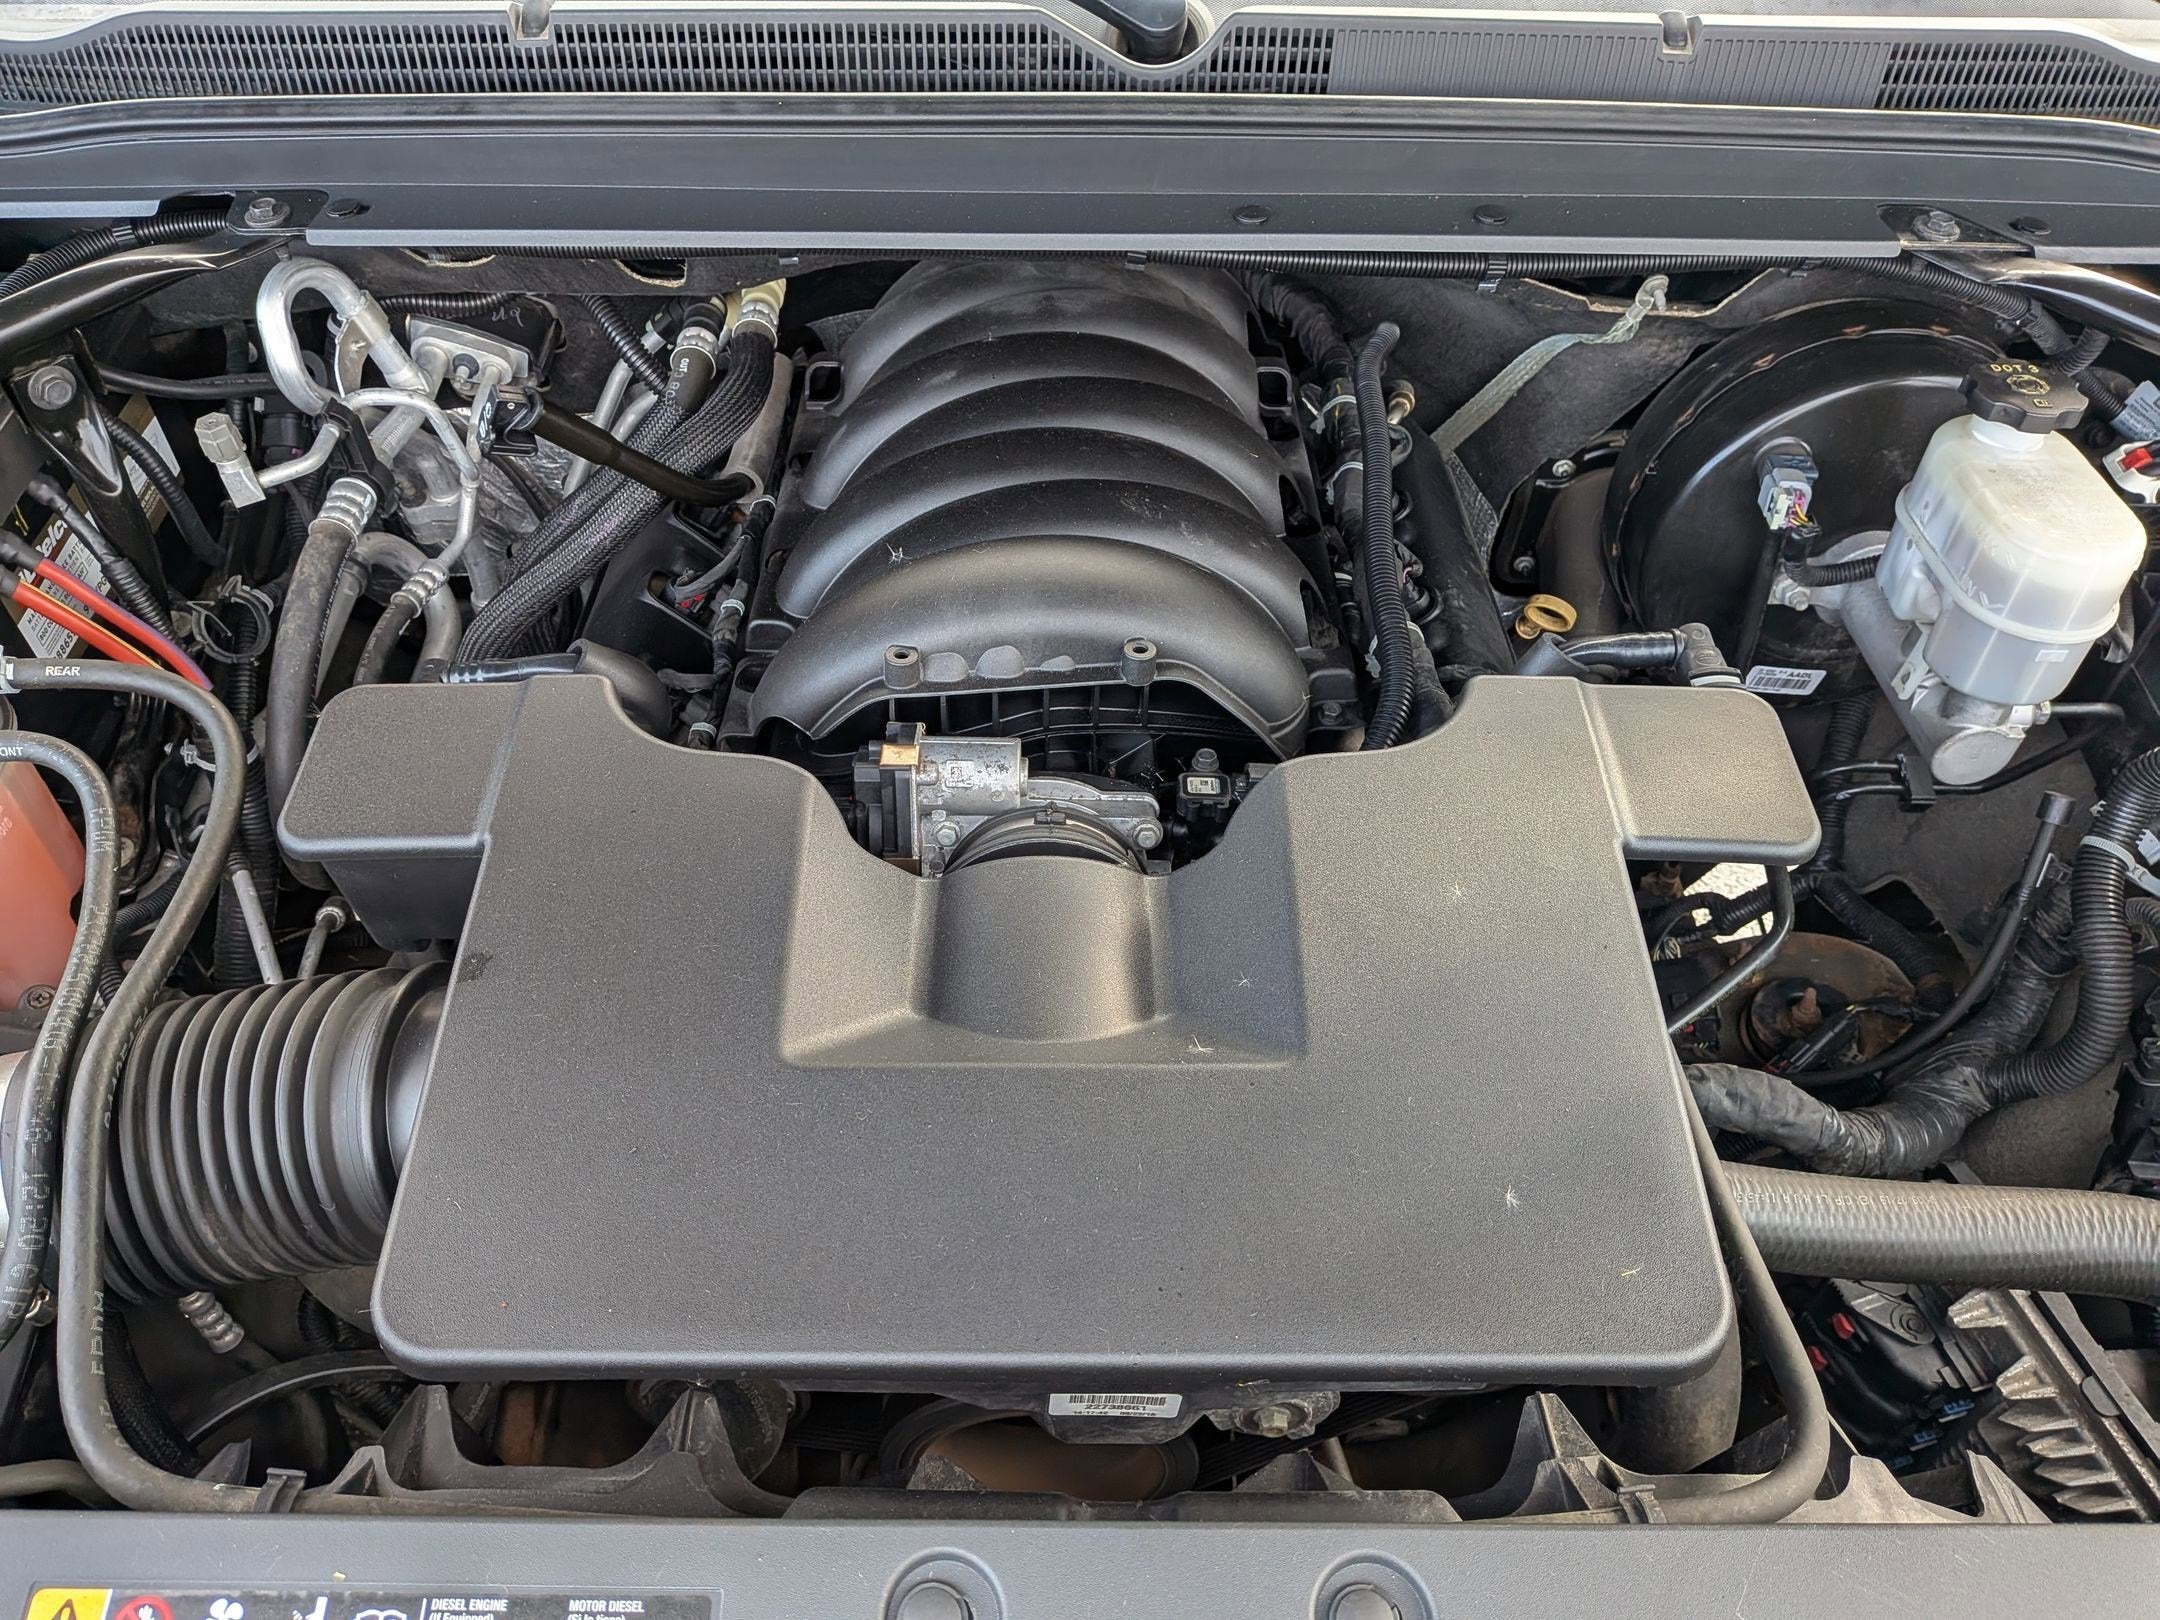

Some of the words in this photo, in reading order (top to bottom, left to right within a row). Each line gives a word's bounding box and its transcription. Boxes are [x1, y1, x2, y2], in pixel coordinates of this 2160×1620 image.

[1990, 364, 2022, 373] DOT
[2028, 364, 2040, 373] 3
[45, 665, 81, 676] REAR
[431, 1599, 467, 1611] DIESEL
[469, 1599, 509, 1611] ENGINE
[569, 1599, 607, 1612] MOTOR
[608, 1600, 645, 1613] DIESEL
